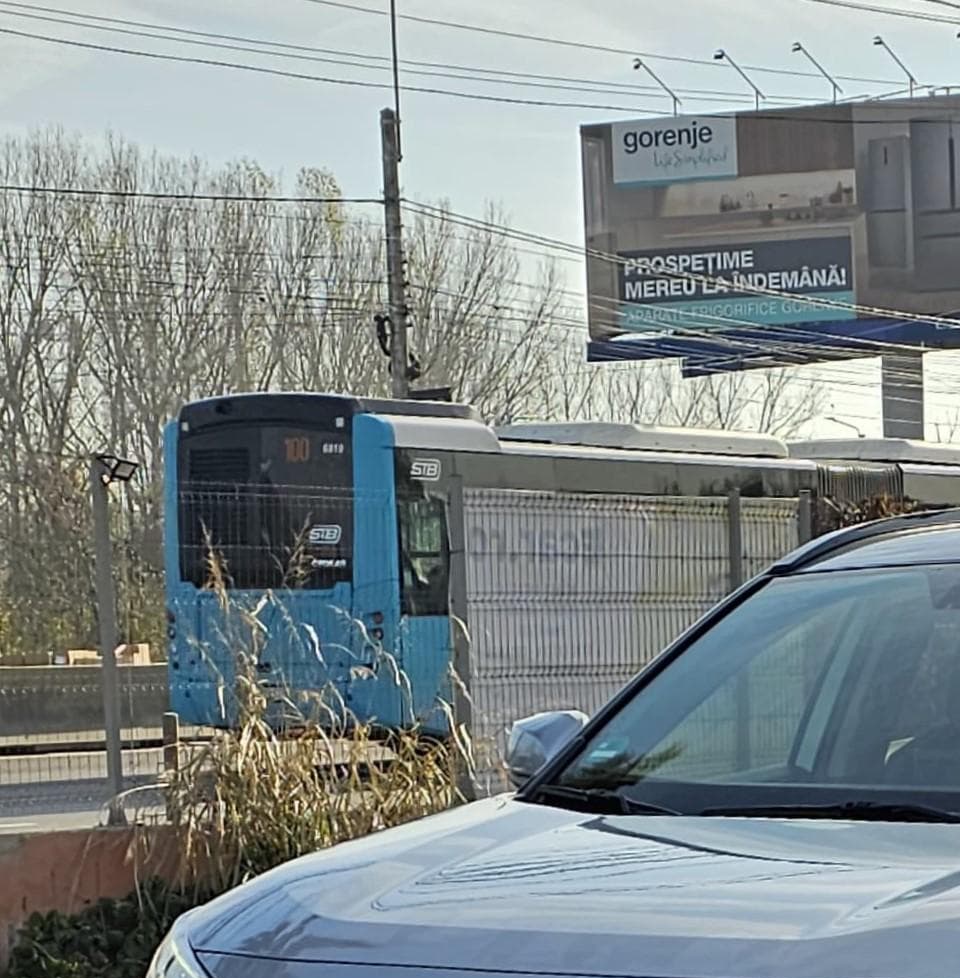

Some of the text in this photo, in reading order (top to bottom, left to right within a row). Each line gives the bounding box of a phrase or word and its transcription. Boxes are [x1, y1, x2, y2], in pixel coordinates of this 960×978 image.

[623, 120, 713, 154] gorenje
[625, 278, 696, 300] MEREU
[285, 438, 310, 462] 100
[410, 460, 439, 478] STB
[309, 526, 340, 542] STB
